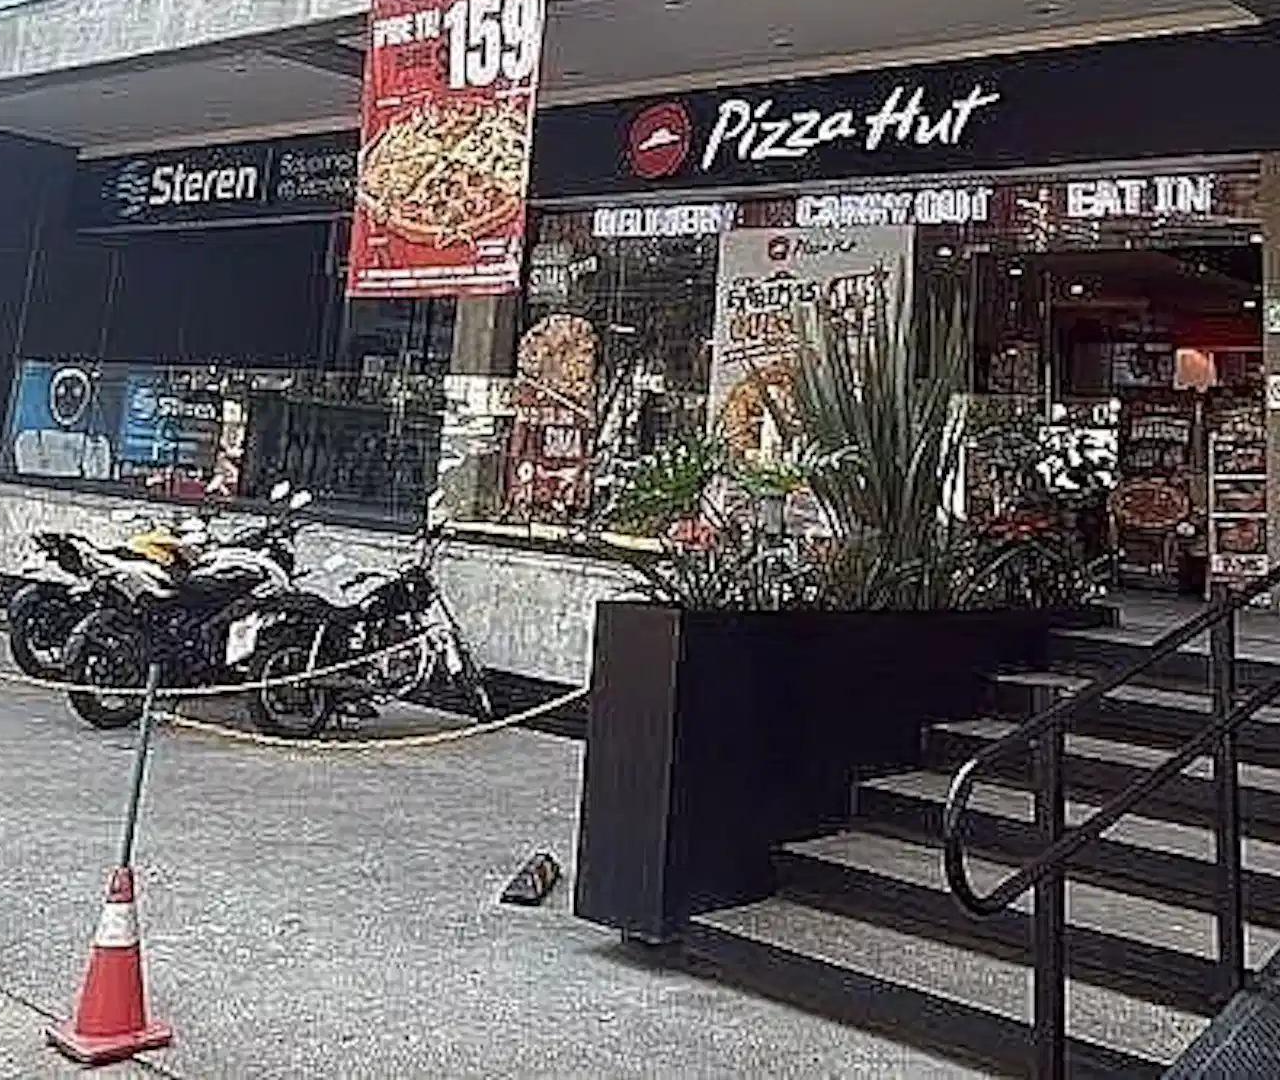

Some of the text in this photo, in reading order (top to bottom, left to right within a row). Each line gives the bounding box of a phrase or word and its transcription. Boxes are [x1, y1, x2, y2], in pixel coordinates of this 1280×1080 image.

[701, 85, 1000, 172] Pizza Hut
[147, 157, 259, 208] Steren
[795, 185, 994, 227] CARRY OUT
[1066, 173, 1214, 220] EAT IN
[592, 202, 736, 238] DELIVERY
